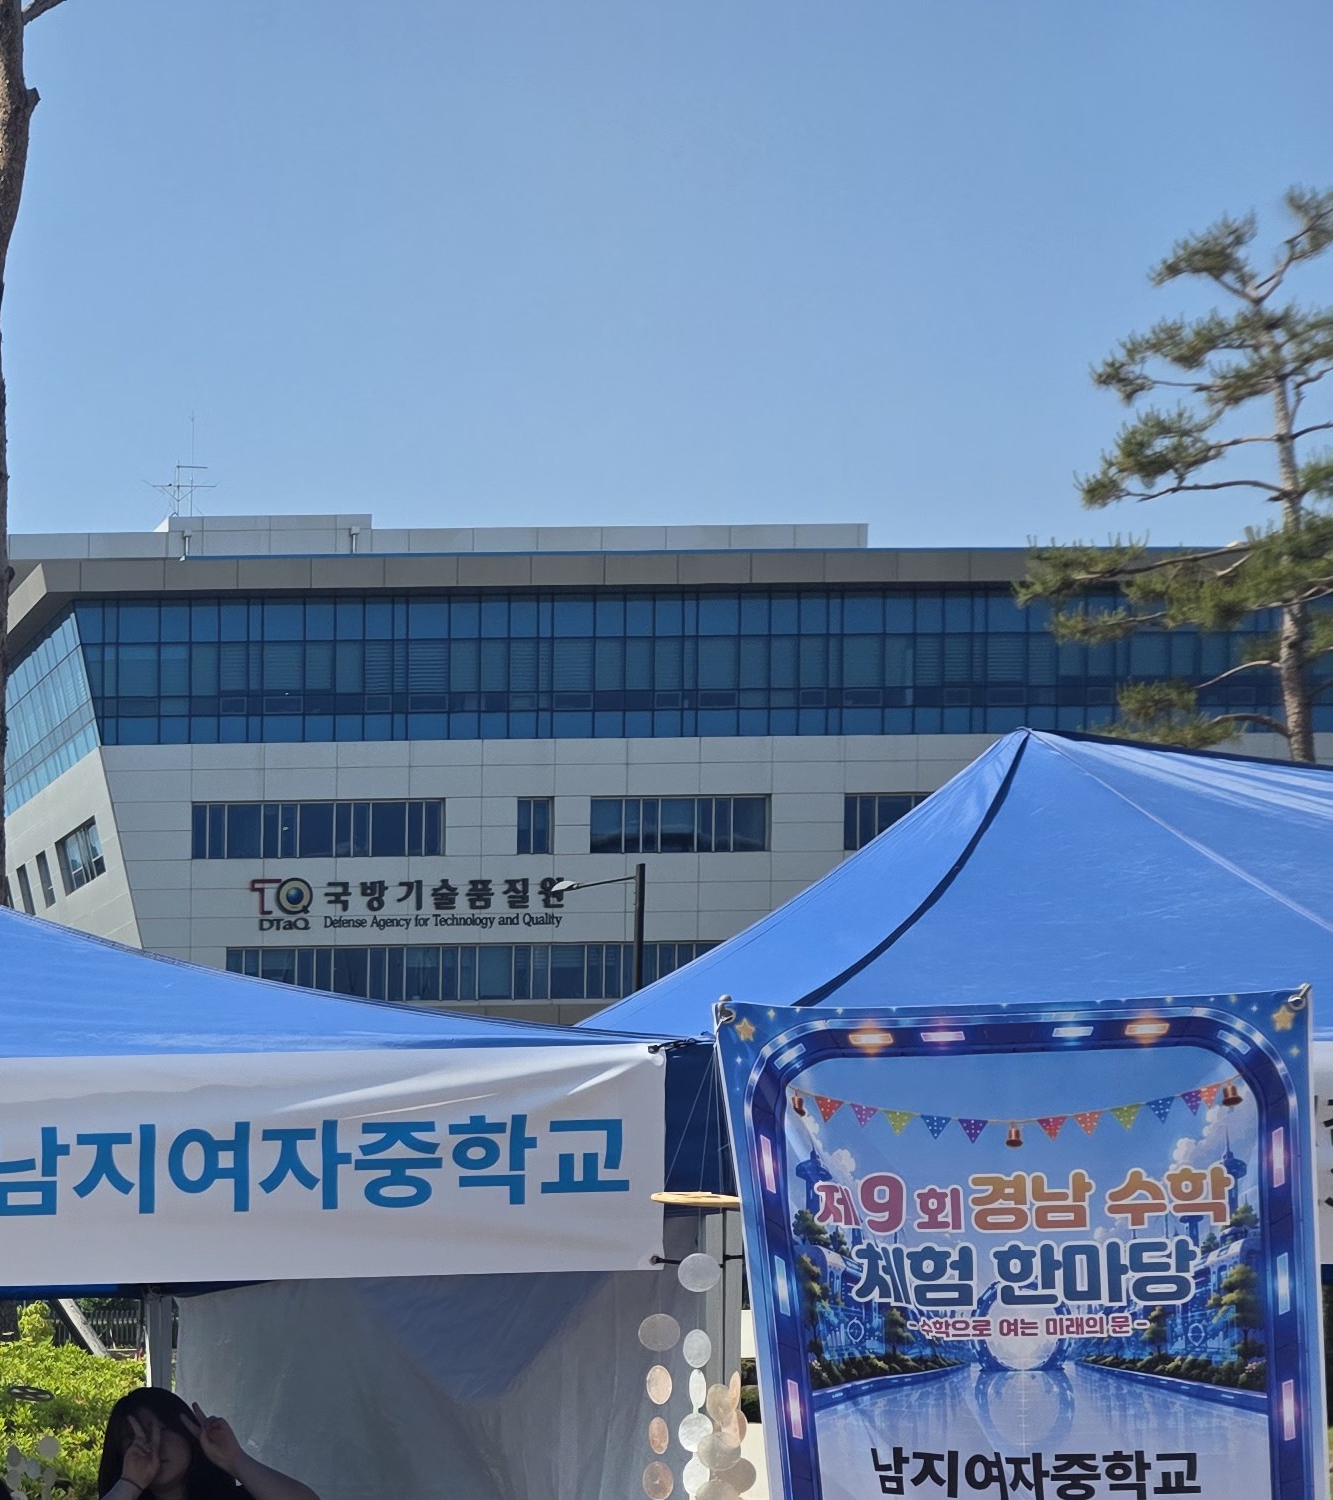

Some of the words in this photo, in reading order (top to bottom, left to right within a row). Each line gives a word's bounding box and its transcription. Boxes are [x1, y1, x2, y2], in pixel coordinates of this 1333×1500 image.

[324, 876, 566, 912] 국방기술품질원
[258, 917, 311, 932] DTaQ
[323, 914, 368, 929] Defense
[370, 914, 412, 931] Agency
[414, 914, 430, 928] for
[433, 913, 496, 929] Technology
[497, 913, 520, 927] and
[522, 912, 563, 928] Quality
[1106, 1165, 1233, 1226] 수학
[852, 1240, 977, 1308] 체험
[990, 1236, 1201, 1307] 한마당
[998, 1316, 1039, 1338] 여는
[1045, 1315, 1105, 1337] 미래의
